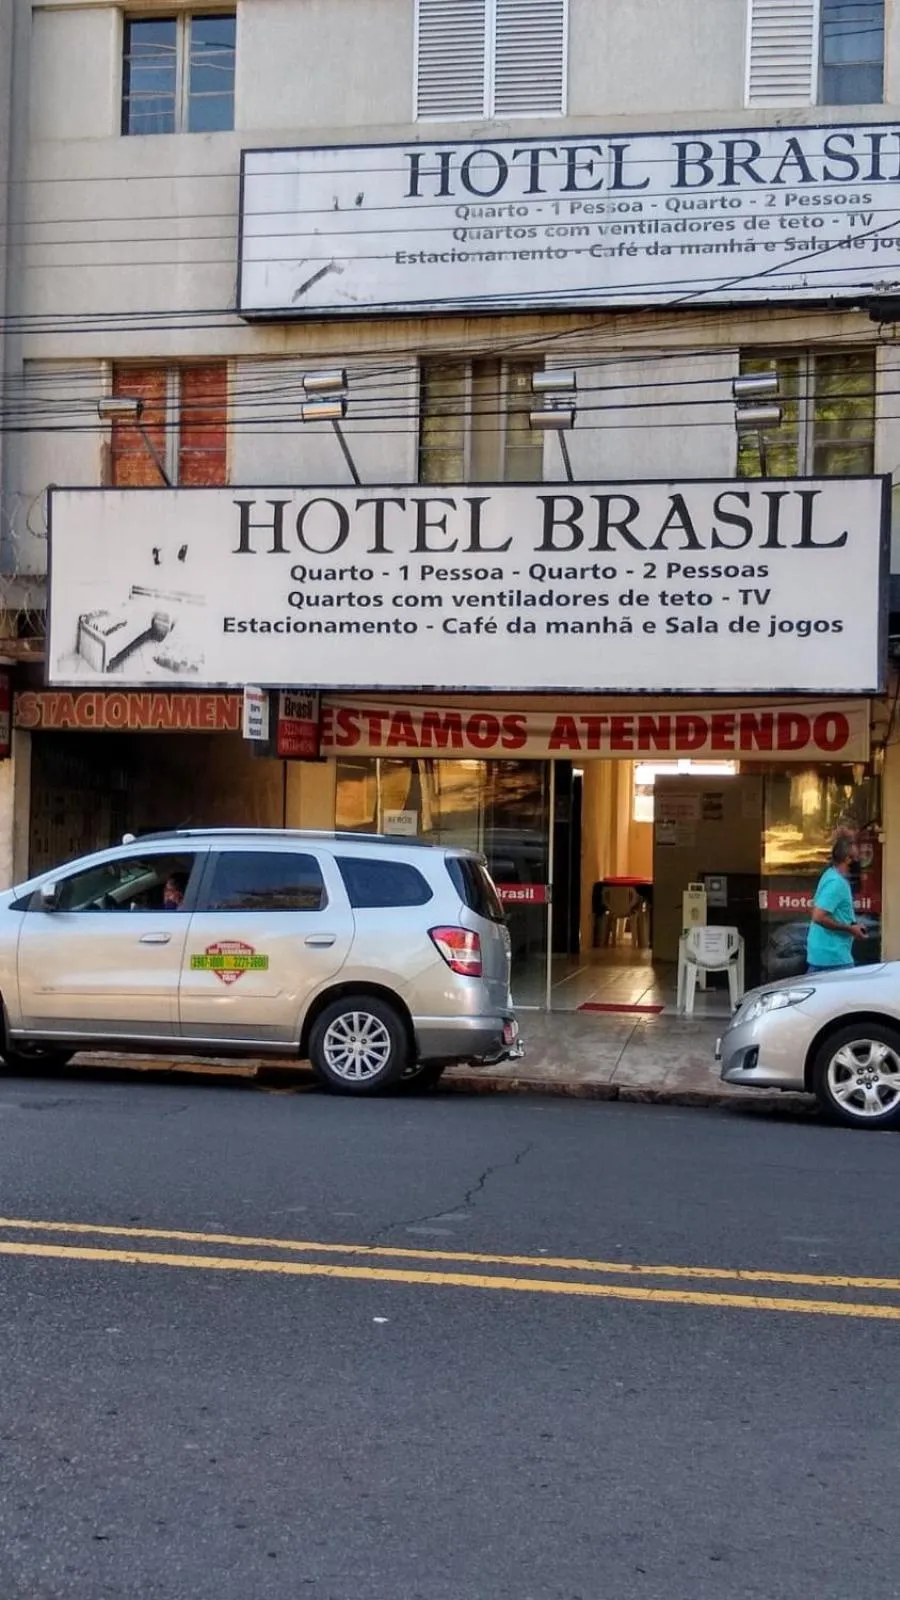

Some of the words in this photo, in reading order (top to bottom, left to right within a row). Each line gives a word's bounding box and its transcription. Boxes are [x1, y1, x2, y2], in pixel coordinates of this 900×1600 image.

[403, 144, 650, 197] HOTEL
[670, 132, 900, 189] BRASI
[455, 203, 529, 220] Quarto
[551, 202, 560, 215] 1
[570, 200, 643, 215] Pessoa
[665, 196, 742, 213] Quarto
[764, 194, 776, 207] 2
[785, 192, 872, 207] Pessoas
[452, 225, 537, 242] Quartos
[544, 225, 590, 238] com
[598, 217, 735, 235] ventiladores
[743, 215, 770, 231] de
[778, 215, 824, 230] teto
[846, 213, 874, 227] TV
[589, 242, 638, 258] Café
[645, 241, 671, 256] da
[680, 238, 761, 254] manhã
[764, 240, 776, 252] e
[784, 236, 830, 251] Sala
[838, 235, 865, 250] de
[231, 496, 513, 554] HOTEL
[533, 490, 848, 552] BRASIL
[290, 564, 374, 582] Quarto
[399, 565, 408, 580] 1
[420, 564, 503, 581] Pessoa
[529, 563, 617, 580] Quarto
[643, 562, 657, 579] 2
[666, 562, 769, 578] Pessoas
[287, 590, 384, 609] Quartos
[392, 594, 443, 607] com
[451, 589, 609, 607] ventiladores
[619, 589, 649, 606] de
[658, 590, 713, 606] teto
[738, 588, 771, 605] TV
[223, 616, 418, 634] Estacionamento
[442, 616, 498, 634] Café
[507, 616, 536, 634] da
[546, 616, 633, 634] manhã
[642, 620, 656, 633] e
[666, 616, 717, 634] Sala
[728, 616, 760, 633] de
[768, 615, 843, 637] jogos
[548, 711, 850, 753] ATENDENDO
